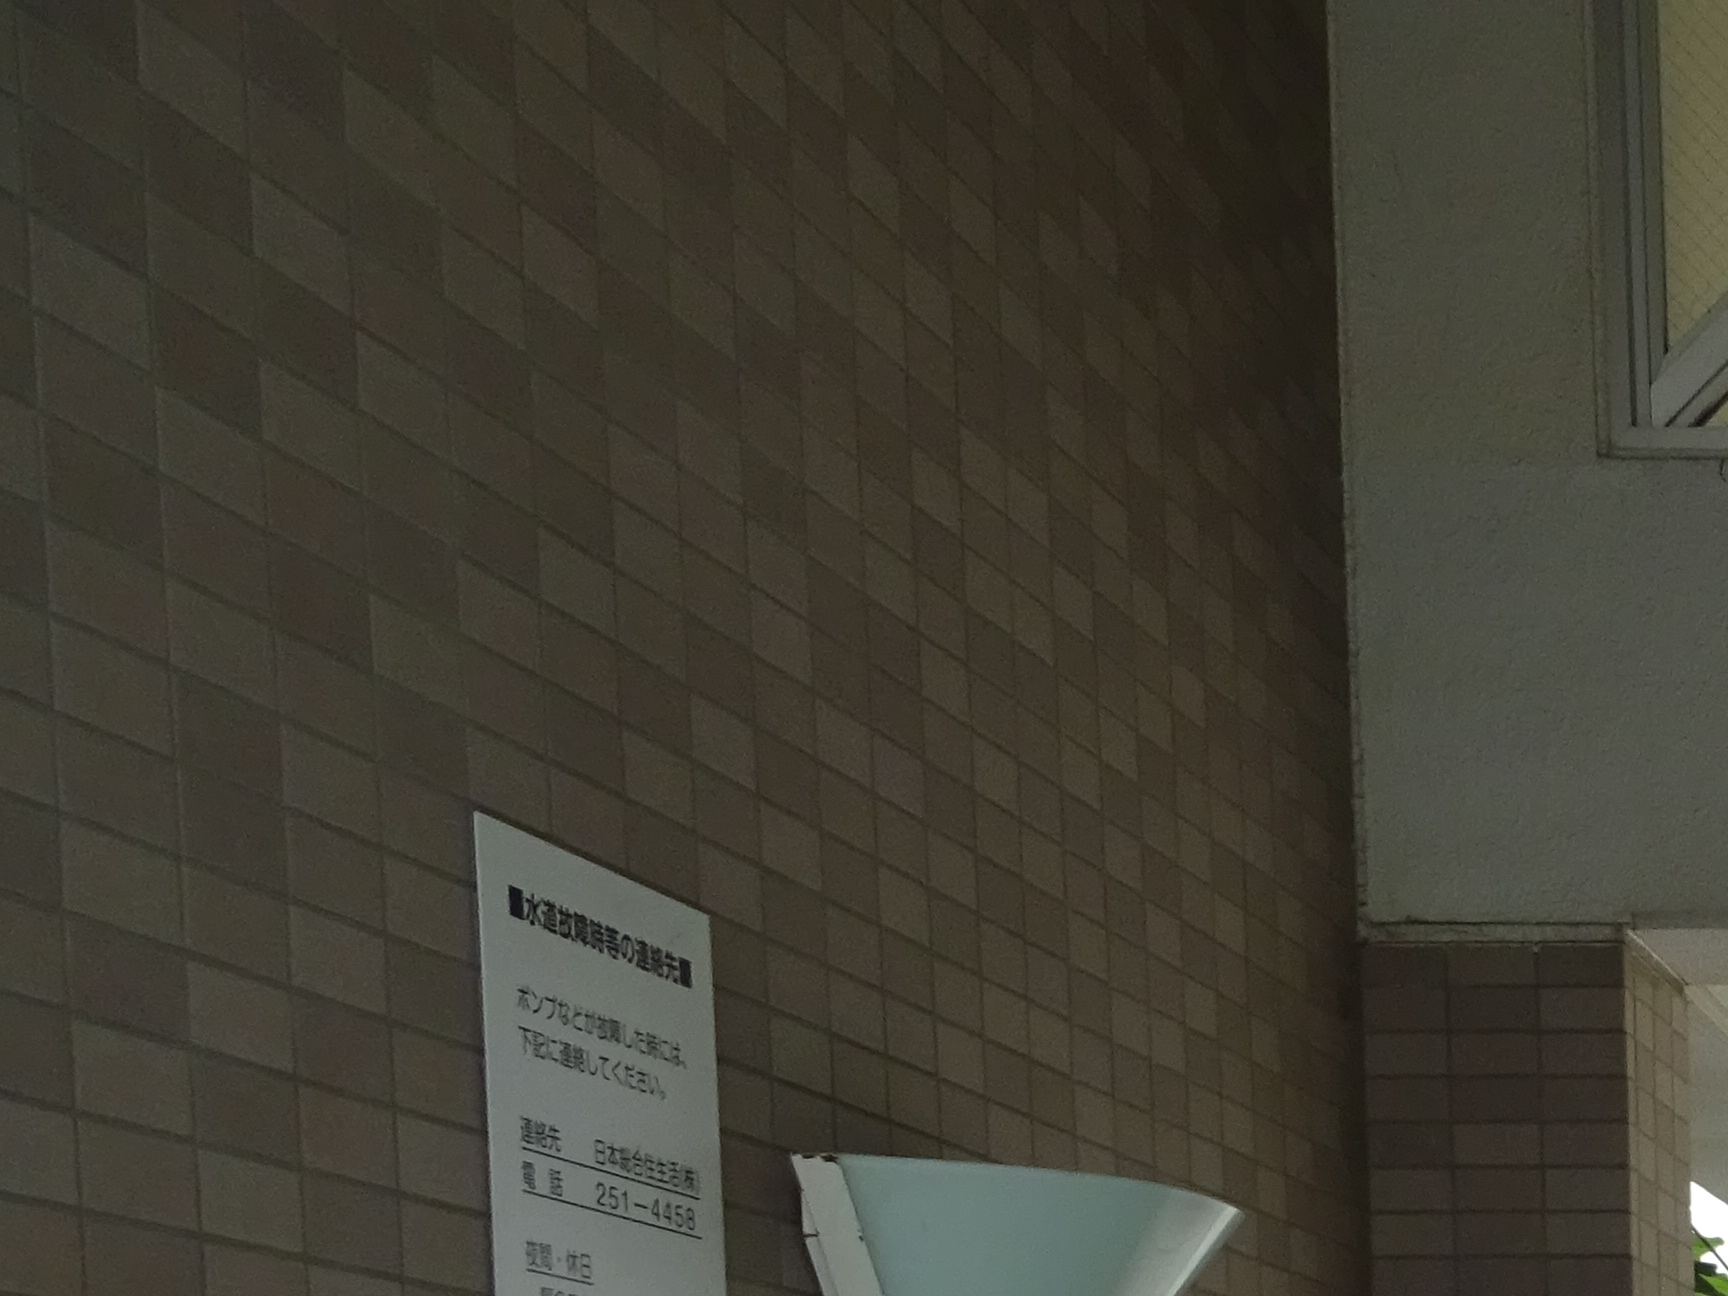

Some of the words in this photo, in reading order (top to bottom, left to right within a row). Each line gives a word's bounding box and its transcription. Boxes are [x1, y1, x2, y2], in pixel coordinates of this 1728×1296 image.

[518, 1024, 666, 1100] 下記に連絡してください。
[520, 1115, 562, 1152] 連絡先
[595, 1181, 697, 1232] 251-4458
